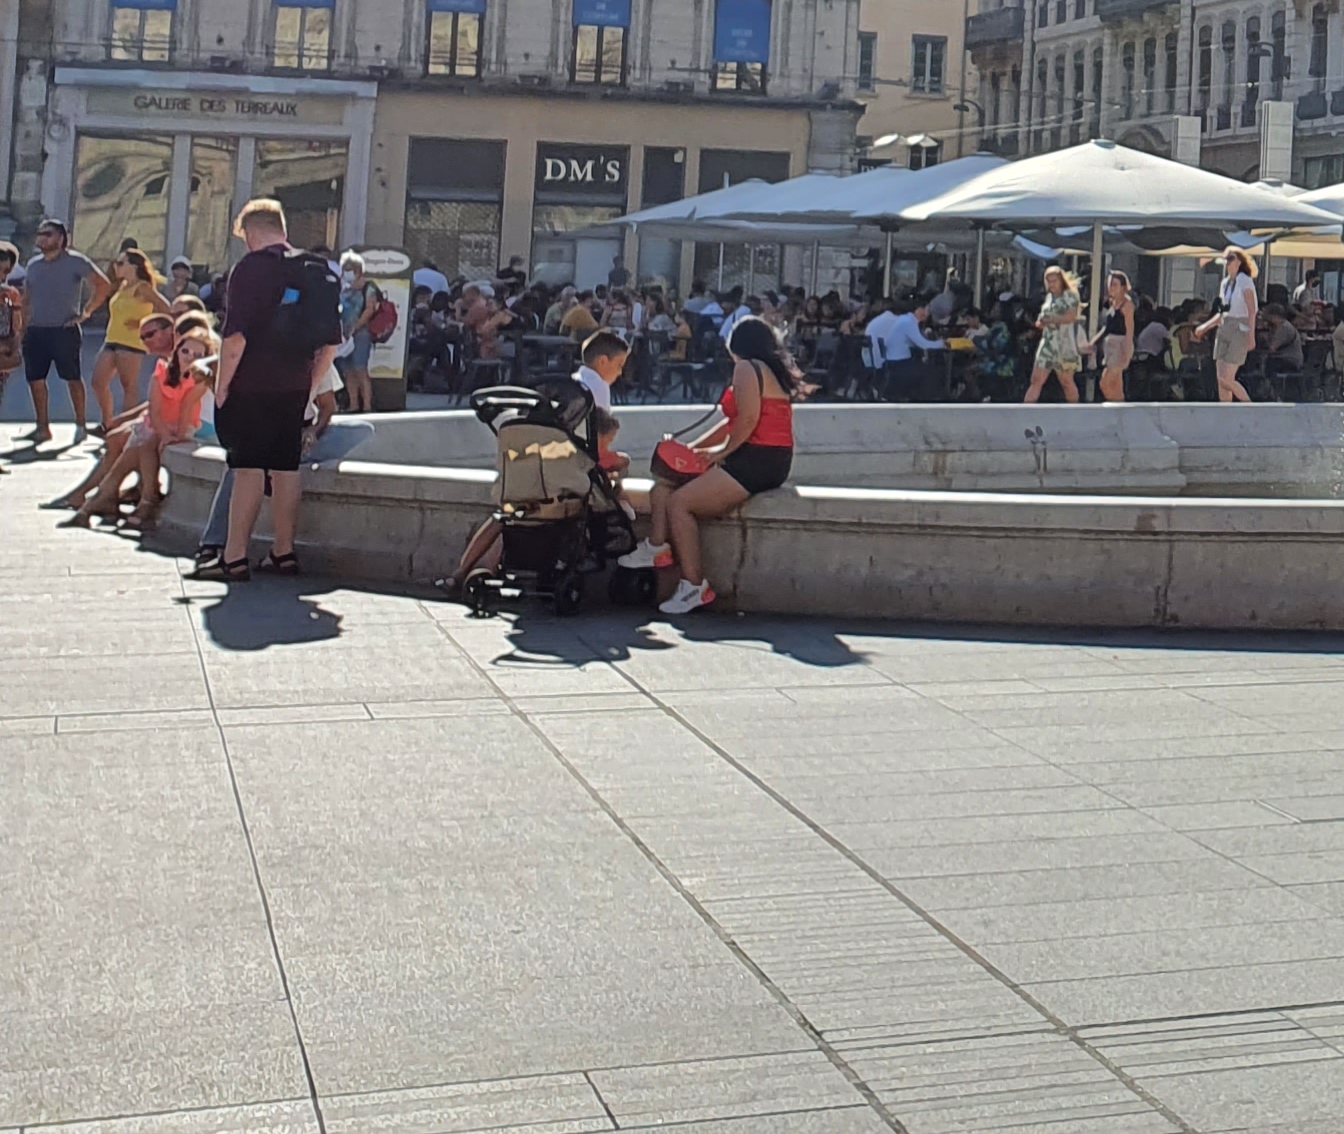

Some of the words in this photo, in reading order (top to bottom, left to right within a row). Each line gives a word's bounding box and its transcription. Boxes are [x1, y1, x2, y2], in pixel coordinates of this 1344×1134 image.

[133, 95, 192, 112] GALERIE
[200, 97, 226, 113] DES
[234, 99, 299, 117] TERREAUX
[543, 154, 621, 183] DM'S
